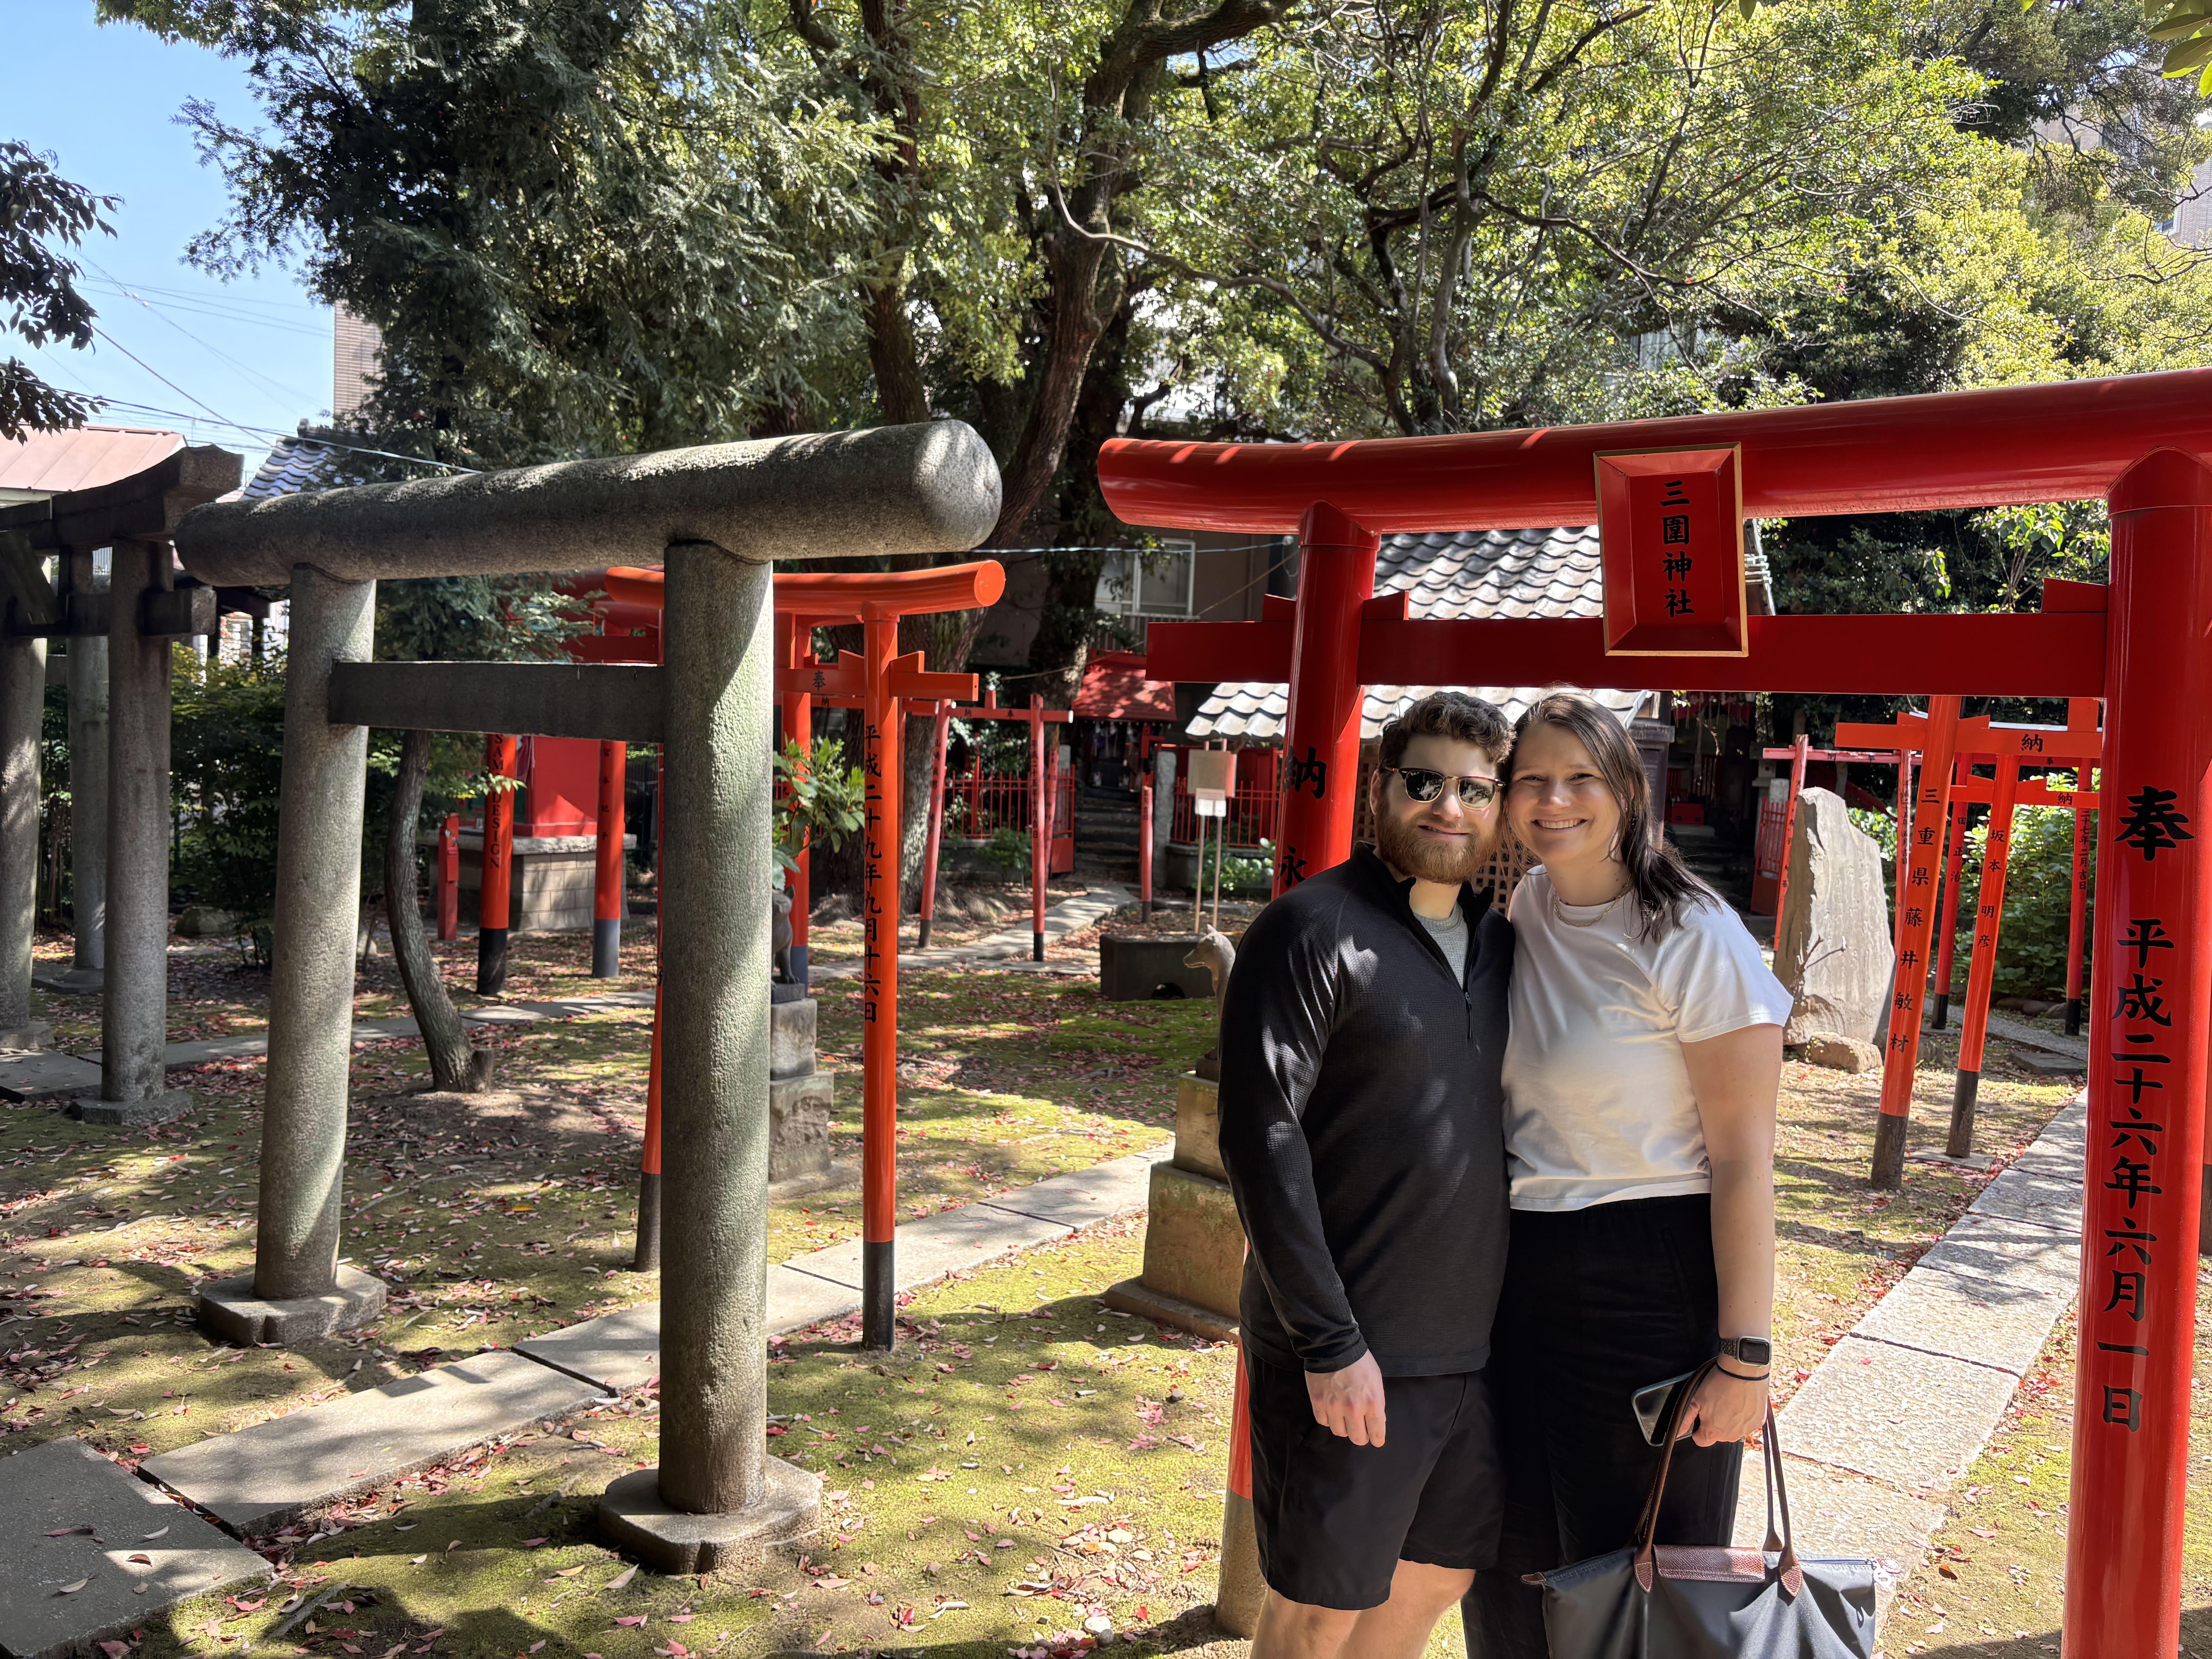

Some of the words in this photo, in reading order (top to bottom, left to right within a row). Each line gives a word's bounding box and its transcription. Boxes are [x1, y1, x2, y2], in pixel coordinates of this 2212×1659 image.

[813, 670, 826, 691] 奉
[1284, 745, 1326, 799] 納
[2021, 734, 2043, 752] 納
[490, 792, 501, 868] DESIGN
[2057, 793, 2072, 805] 納
[2114, 785, 2195, 862] 奉
[1277, 845, 1307, 888] 永
[2078, 788, 2091, 890] 二十七年二月吉日
[865, 725, 882, 1023] 平成二十九年九月十六日
[2097, 918, 2175, 1432] 平成二十六年六月一日
